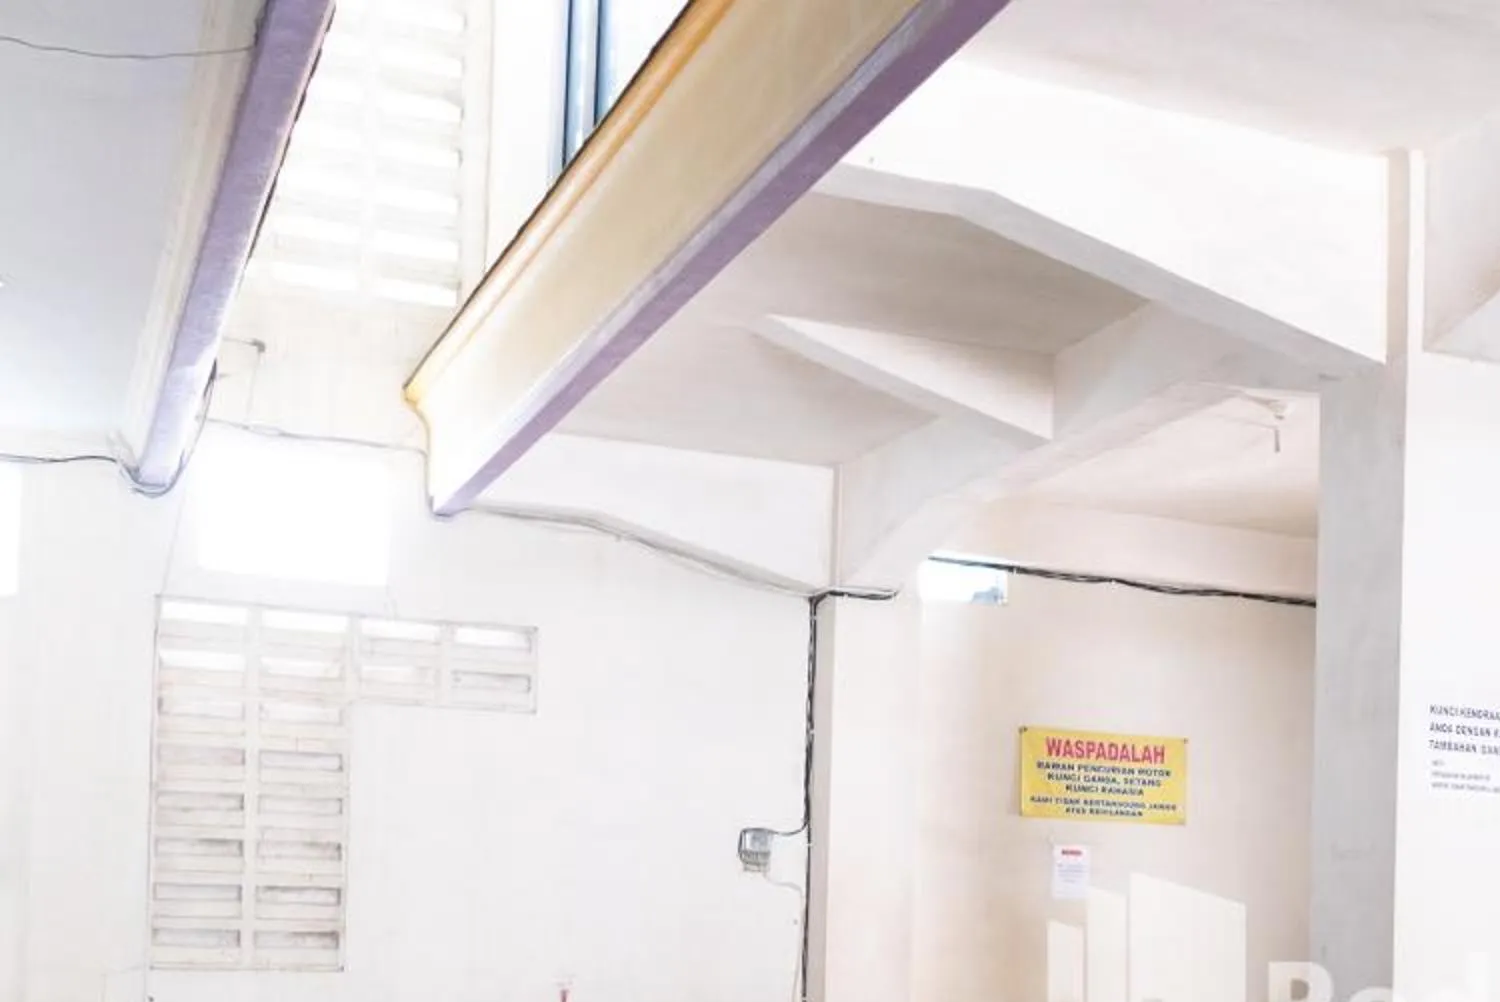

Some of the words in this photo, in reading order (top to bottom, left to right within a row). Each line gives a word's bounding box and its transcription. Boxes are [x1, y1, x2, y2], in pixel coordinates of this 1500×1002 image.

[1046, 736, 1165, 763] WASPADALAH
[1047, 772, 1080, 781] KUNCI
[1138, 768, 1171, 777] MOTOR
[1065, 784, 1098, 792] KUNCI
